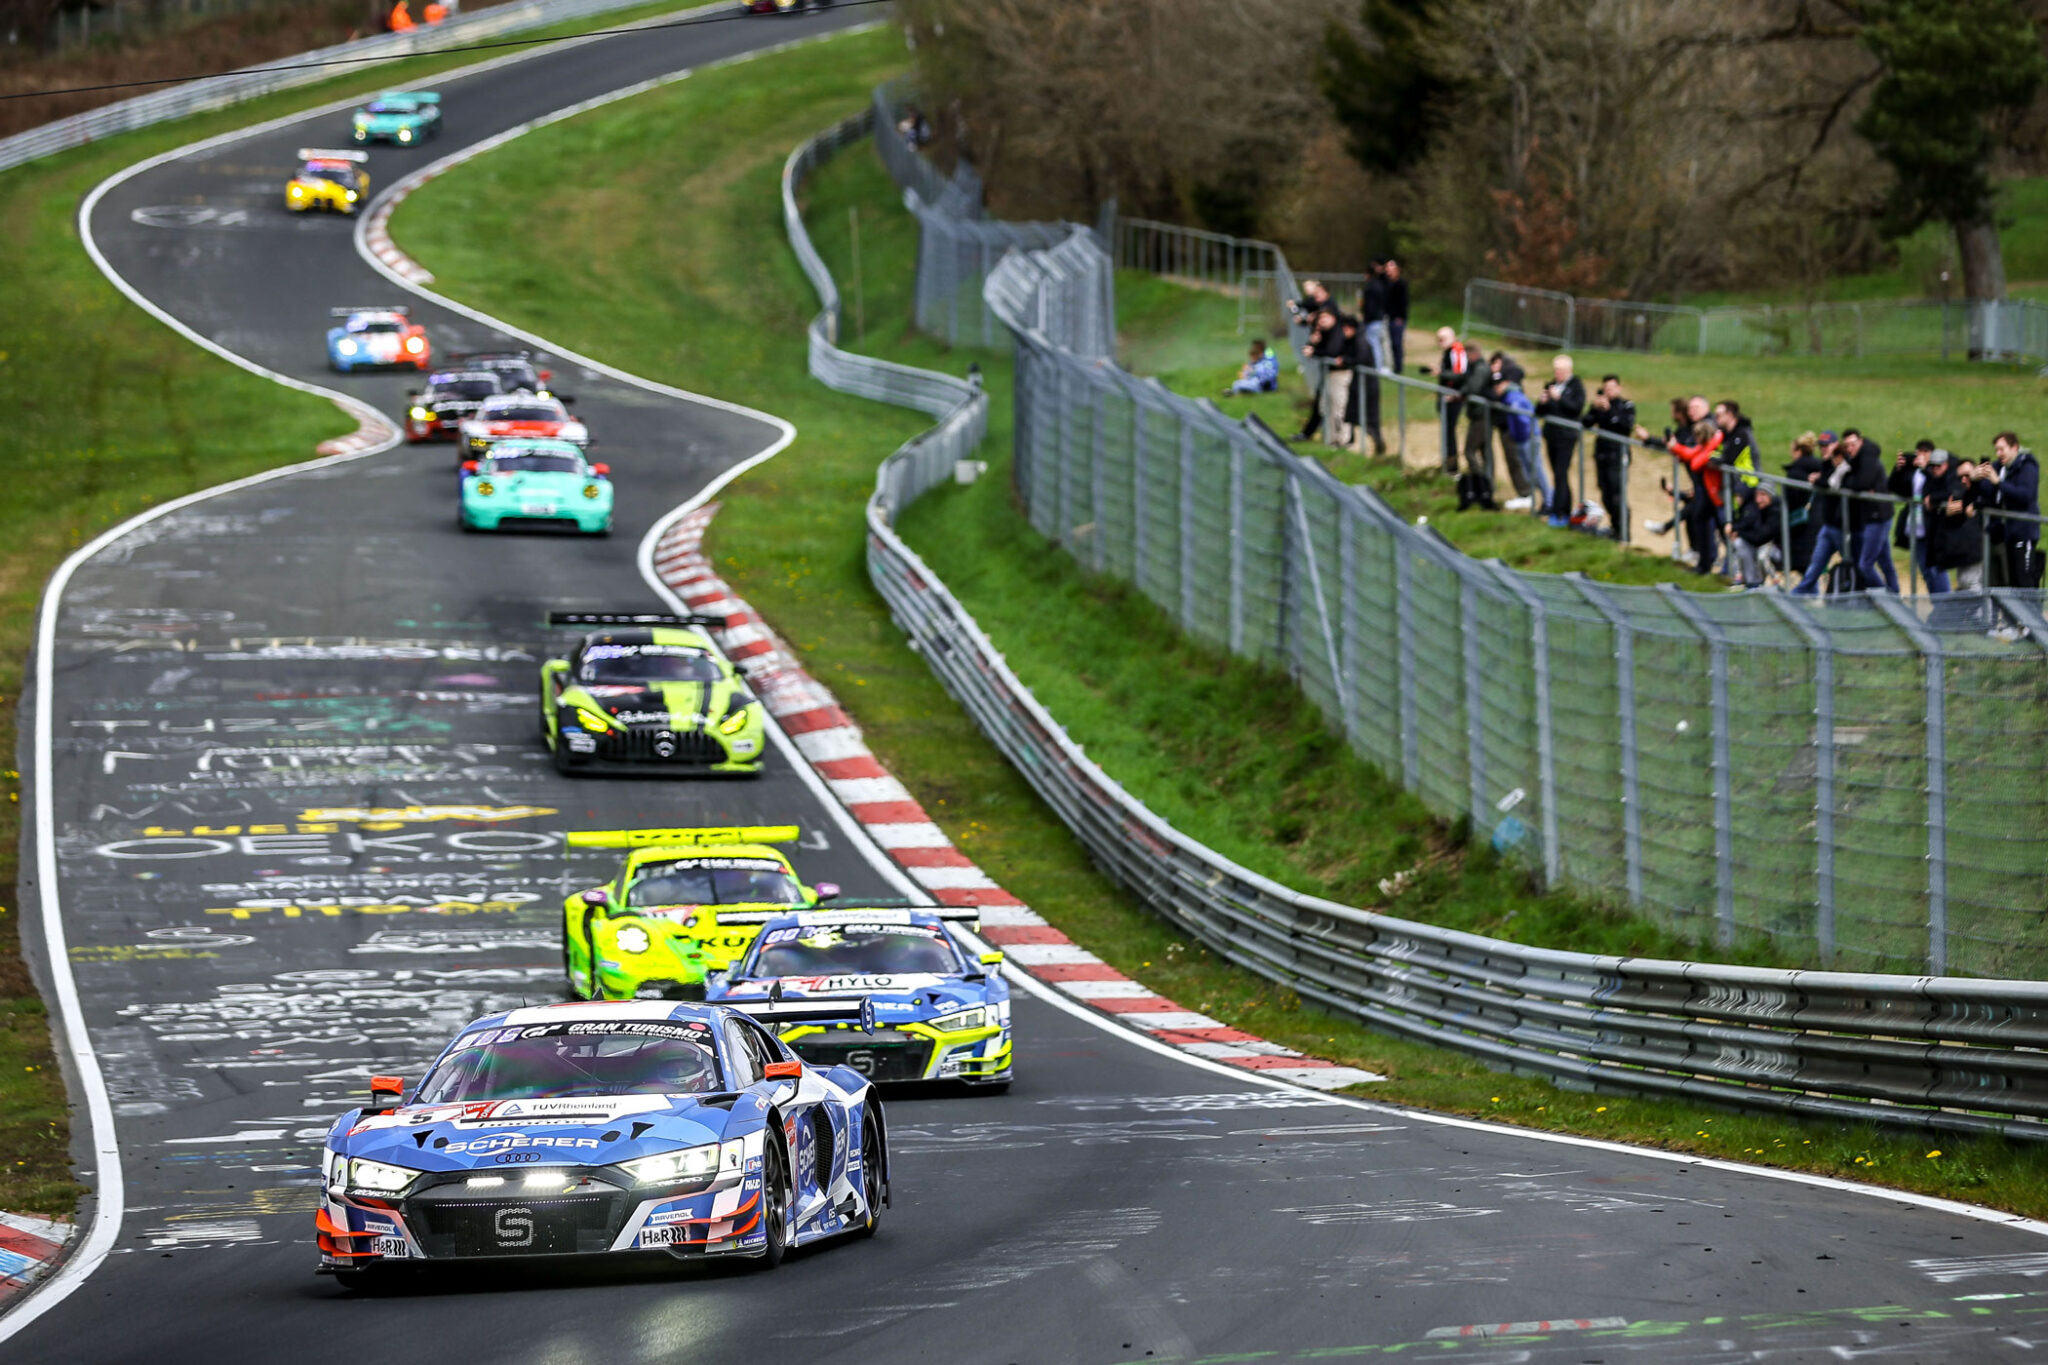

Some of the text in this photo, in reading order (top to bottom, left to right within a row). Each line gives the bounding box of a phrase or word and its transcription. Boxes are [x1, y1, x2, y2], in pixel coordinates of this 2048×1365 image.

[828, 977, 893, 988] HYLO
[568, 1022, 622, 1032] GRAN
[621, 1023, 703, 1040] TURISMO
[647, 1032, 697, 1042] SIMULATOR
[409, 1111, 434, 1124] 5
[444, 1136, 600, 1154] SCHERER
[654, 1212, 690, 1222] RAVENOL
[642, 1227, 671, 1245] H&R
[372, 1238, 393, 1254] H&R
